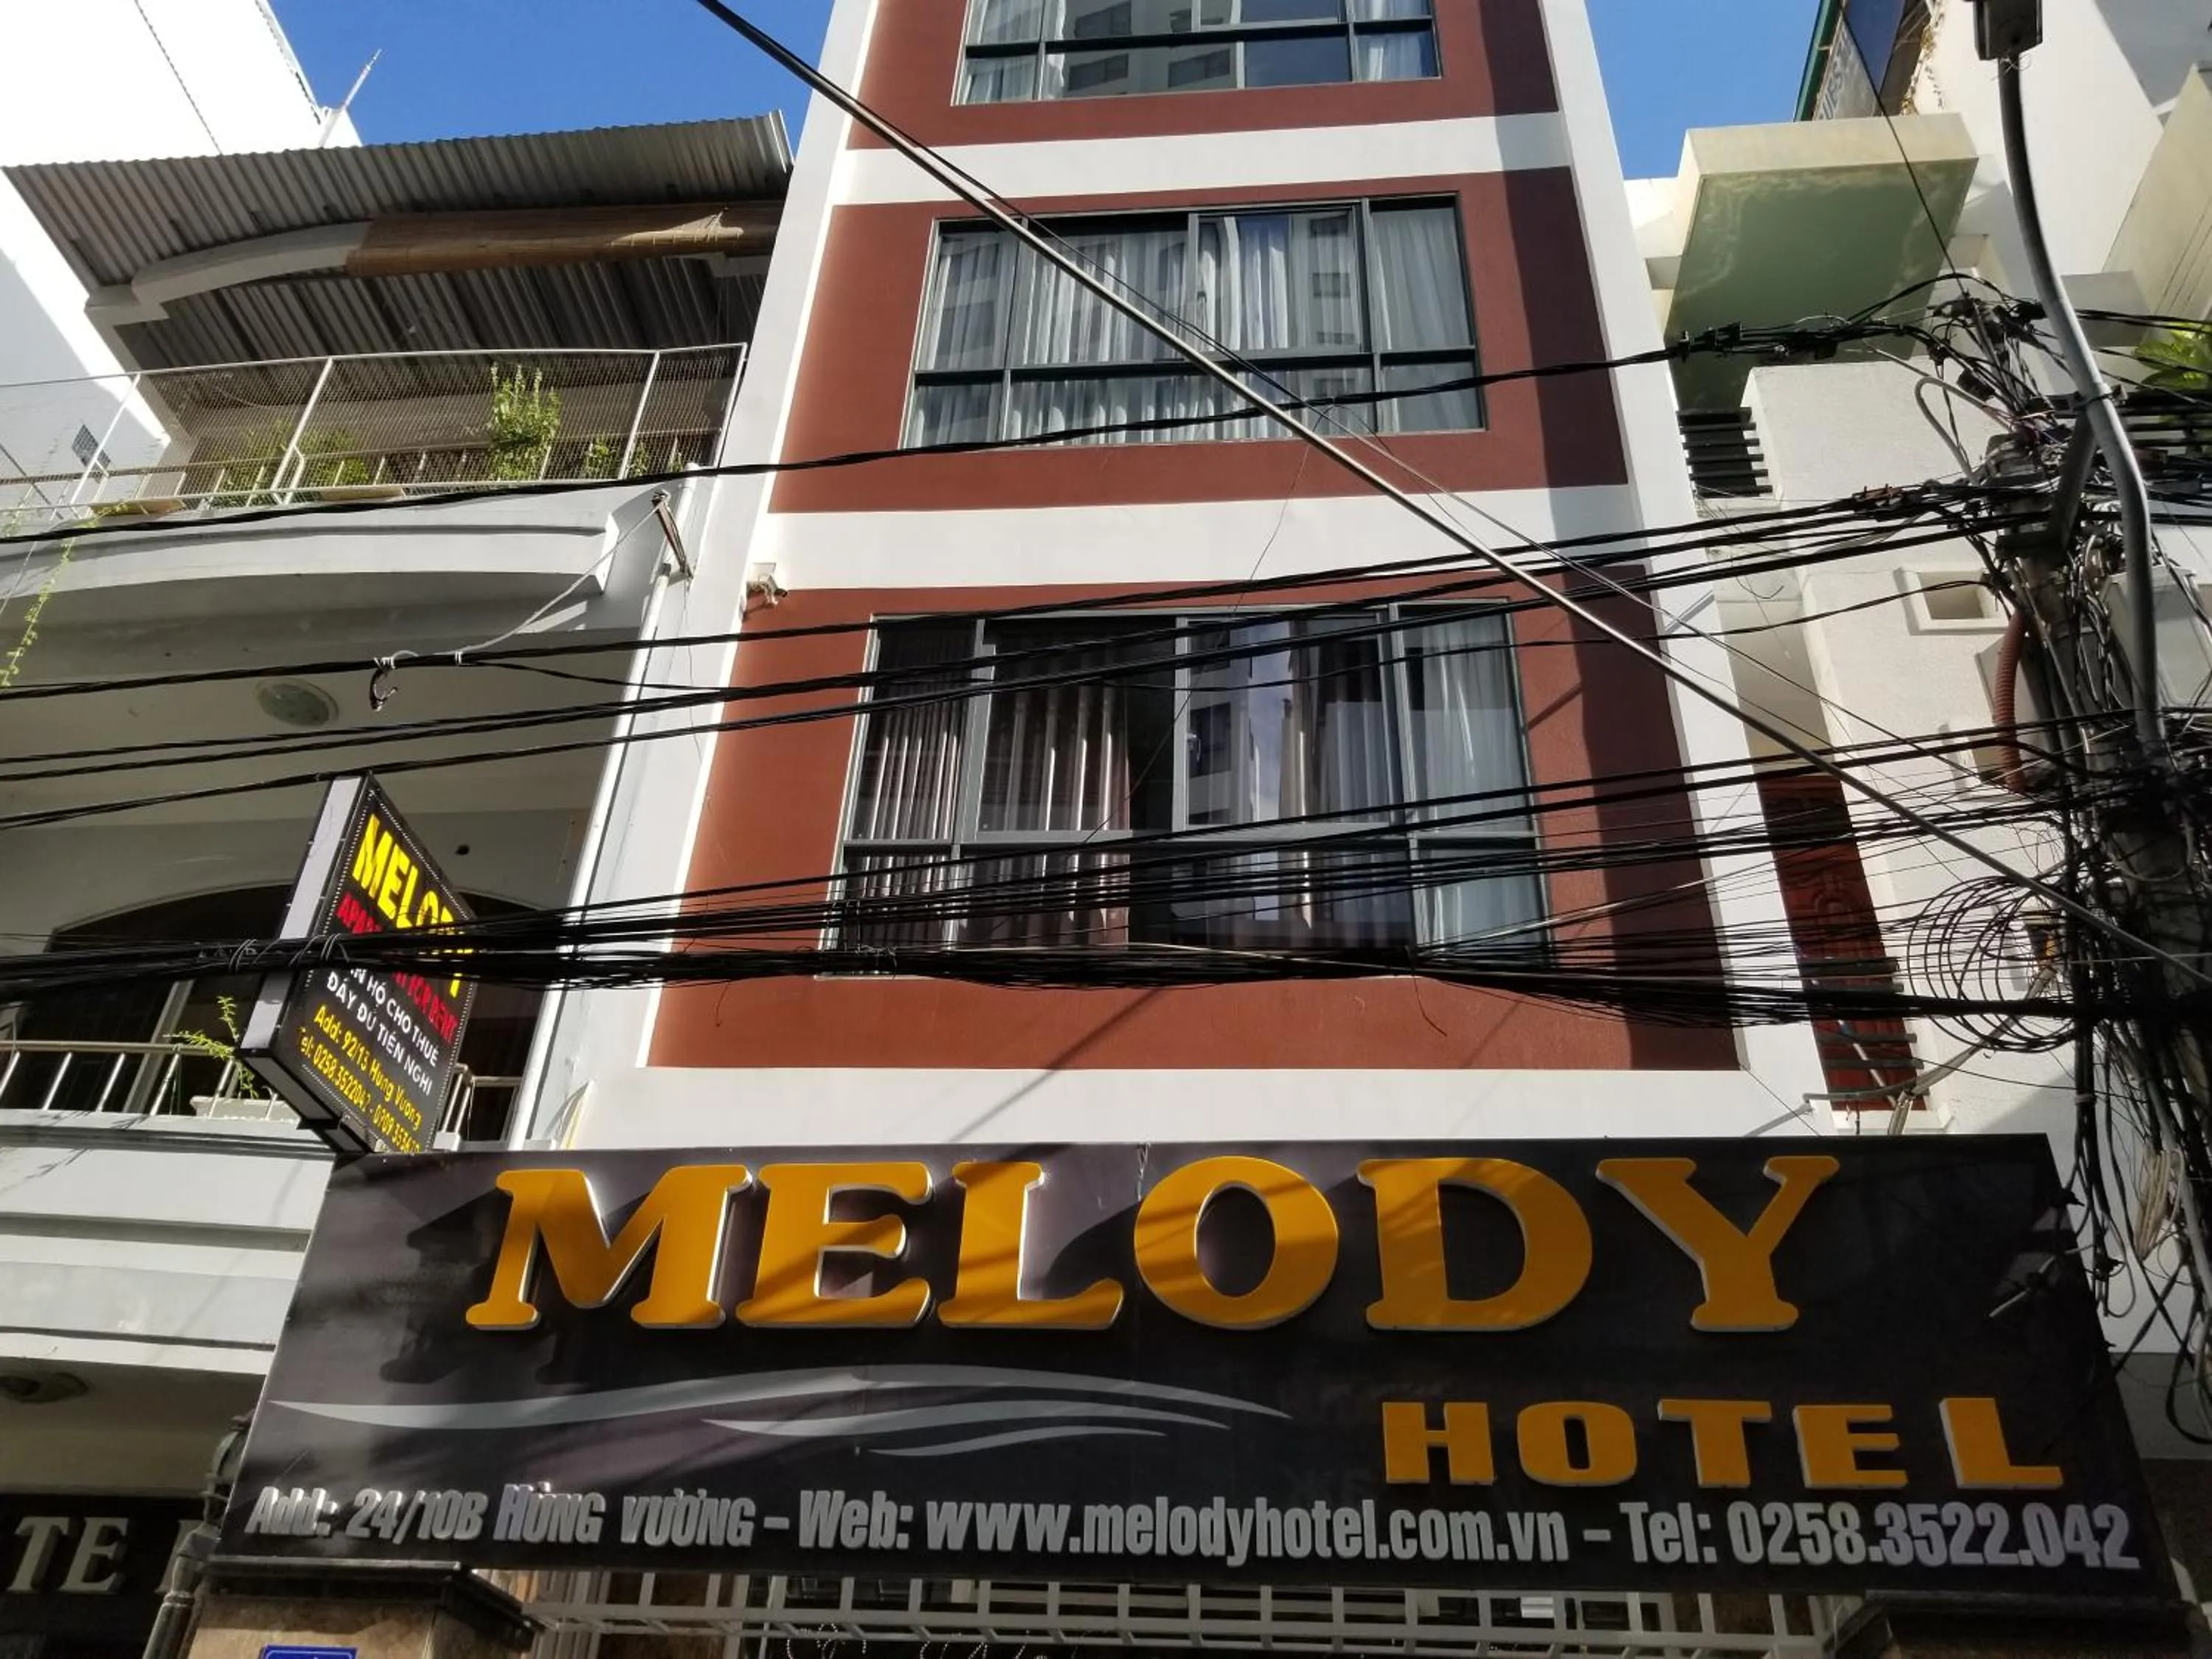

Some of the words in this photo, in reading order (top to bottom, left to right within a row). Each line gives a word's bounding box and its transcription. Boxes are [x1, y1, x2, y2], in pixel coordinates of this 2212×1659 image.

[352, 813, 473, 998] MELO
[313, 1004, 341, 1044] Add:
[341, 1031, 370, 1071] 92/13
[386, 998, 411, 1033] CHO
[465, 1155, 1840, 1332] MELODY
[1382, 1397, 2062, 1489] HOTEL
[244, 1486, 339, 1537] Add:
[345, 1488, 488, 1545] 24/10B
[799, 1489, 914, 1550] Web:
[925, 1495, 1568, 1567] www.melodyhotel.com.vn
[1620, 1499, 1715, 1565] Tel:
[1728, 1501, 2140, 1570] 0258.3522.042
